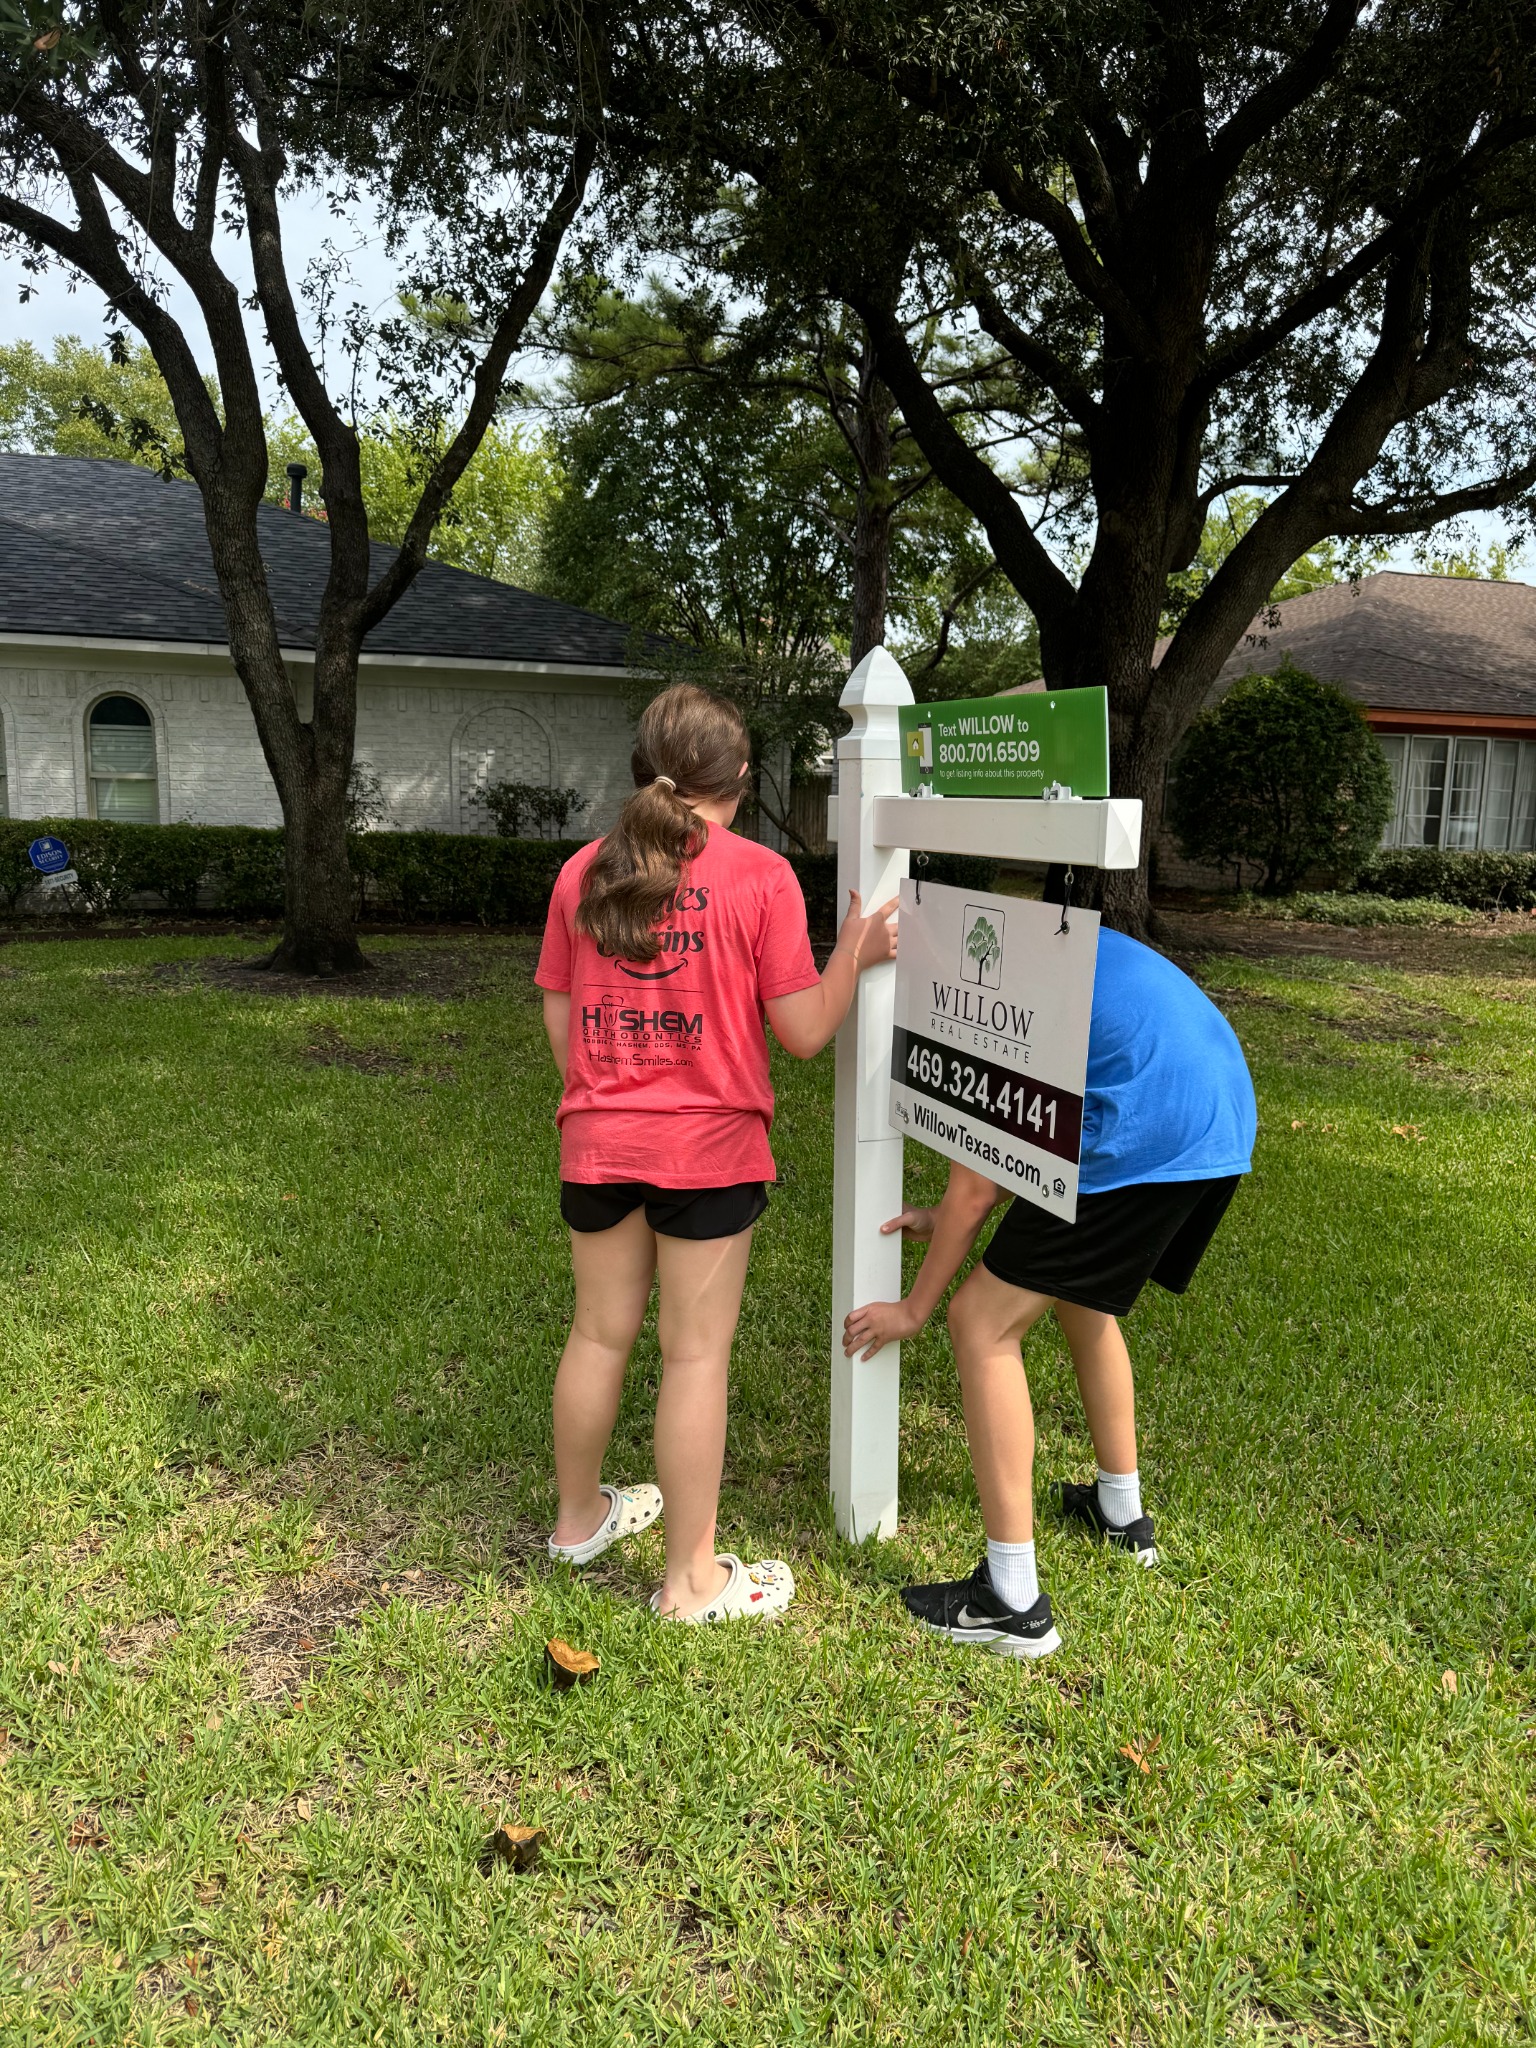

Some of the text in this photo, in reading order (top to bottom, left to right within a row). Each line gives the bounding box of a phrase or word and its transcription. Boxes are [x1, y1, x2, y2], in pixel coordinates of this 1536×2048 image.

[938, 714, 1029, 737] Text WILLOW to
[939, 740, 1040, 763] 800.701.6509
[940, 768, 1045, 780] to get listing info about this property
[36, 850, 62, 860] EDISON
[931, 981, 1035, 1041] WILLOW
[582, 1029, 702, 1043] ORTHODONTICS
[931, 1018, 1031, 1064] REAL ESTATE
[588, 1049, 694, 1067] HashemSmiles.com
[907, 1044, 1058, 1139] 469.324.4141
[913, 1102, 1041, 1187] WillowTexas.com
